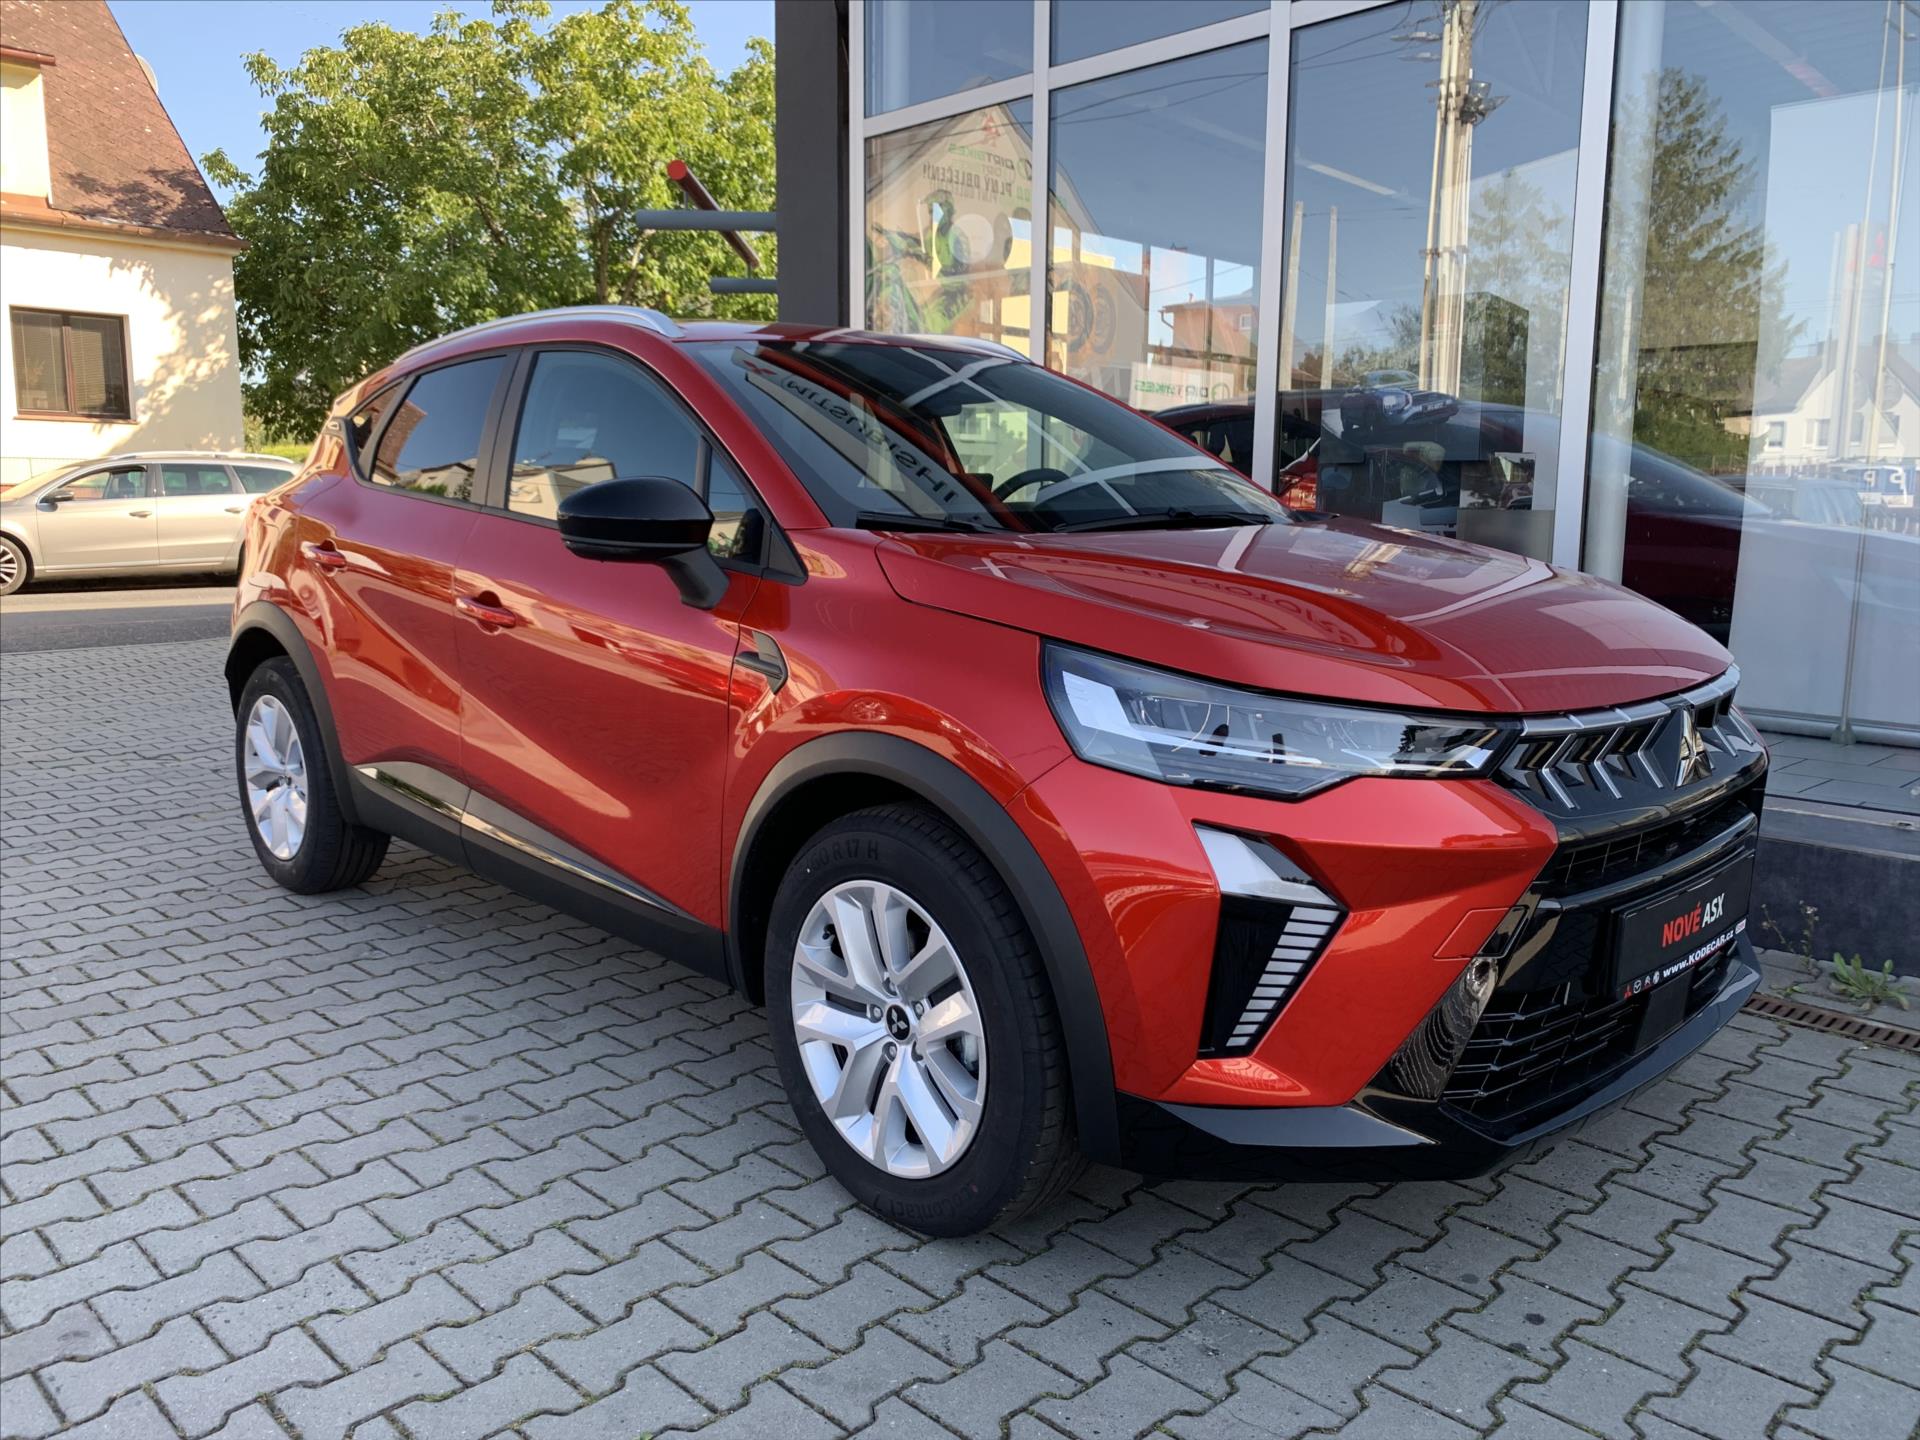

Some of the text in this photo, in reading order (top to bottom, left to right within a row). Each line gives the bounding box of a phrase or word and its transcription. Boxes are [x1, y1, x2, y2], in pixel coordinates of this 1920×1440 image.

[1662, 901, 1702, 948] NOVÉ
[1702, 893, 1725, 928] ASX
[1662, 930, 1734, 978] www.KODECAR.cz
